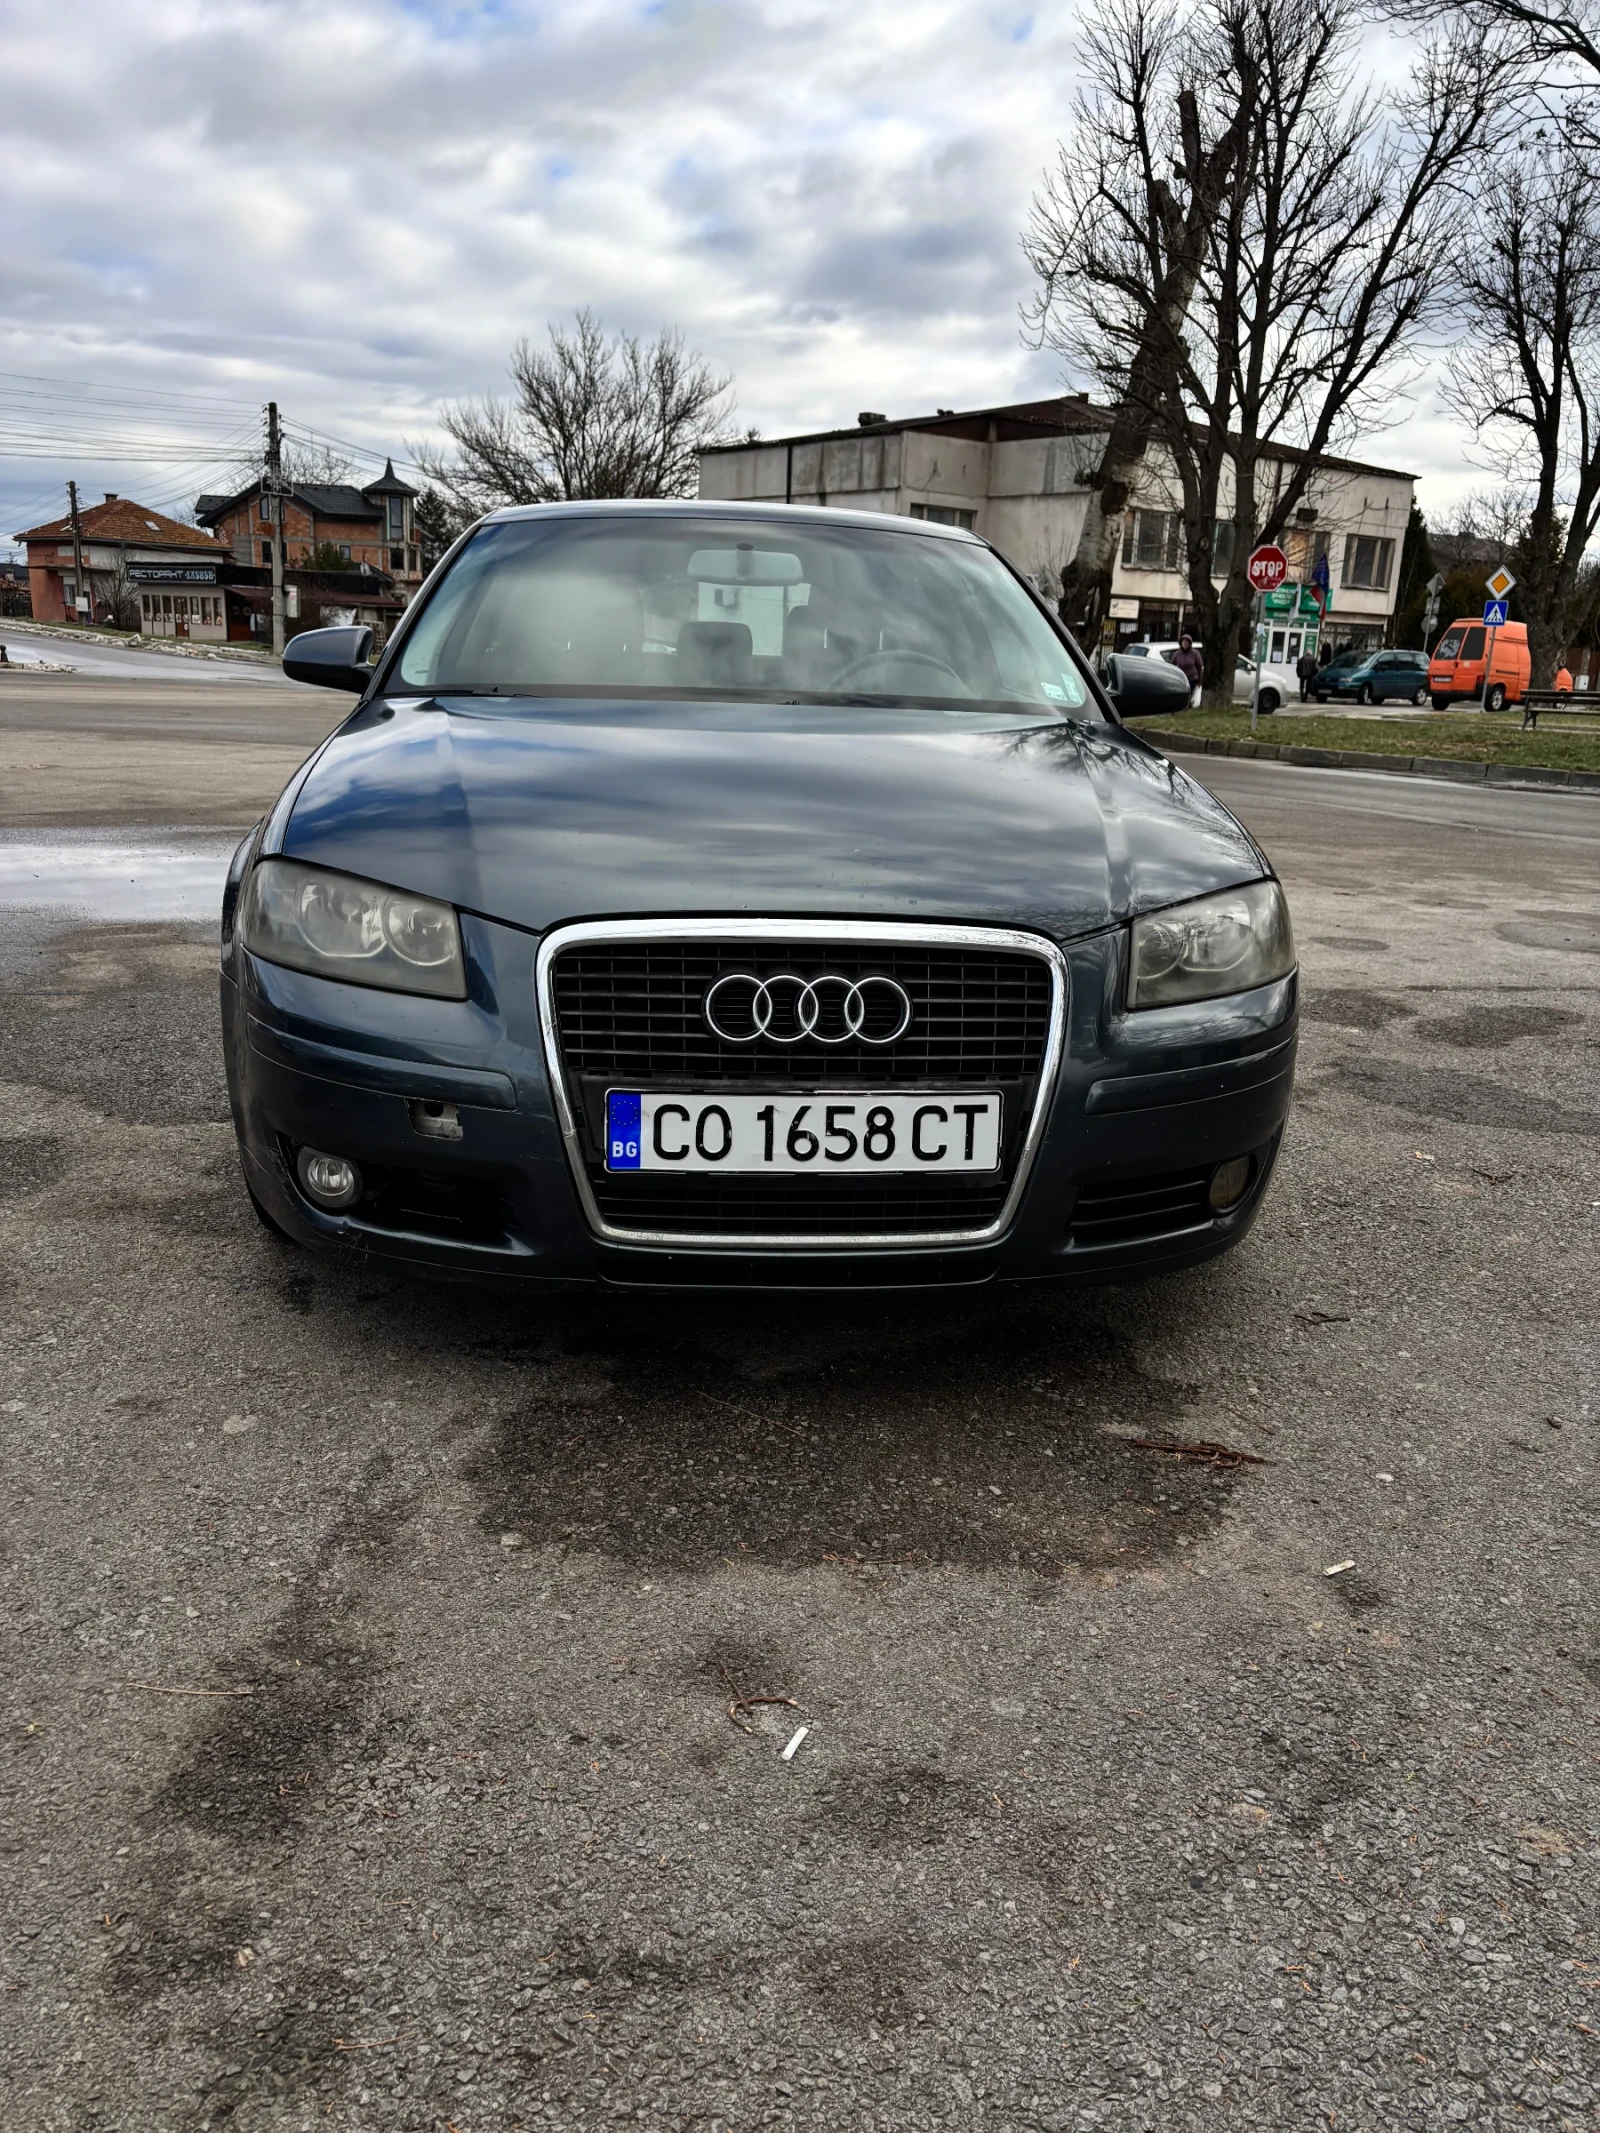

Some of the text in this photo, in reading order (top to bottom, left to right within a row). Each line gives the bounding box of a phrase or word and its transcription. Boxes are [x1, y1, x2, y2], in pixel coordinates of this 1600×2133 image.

[129, 569, 184, 579] РЕСТОРАНТ
[1251, 560, 1284, 577] STOP
[756, 1104, 896, 1163] 1658
[911, 1103, 989, 1162] CT
[611, 1140, 638, 1158] BG
